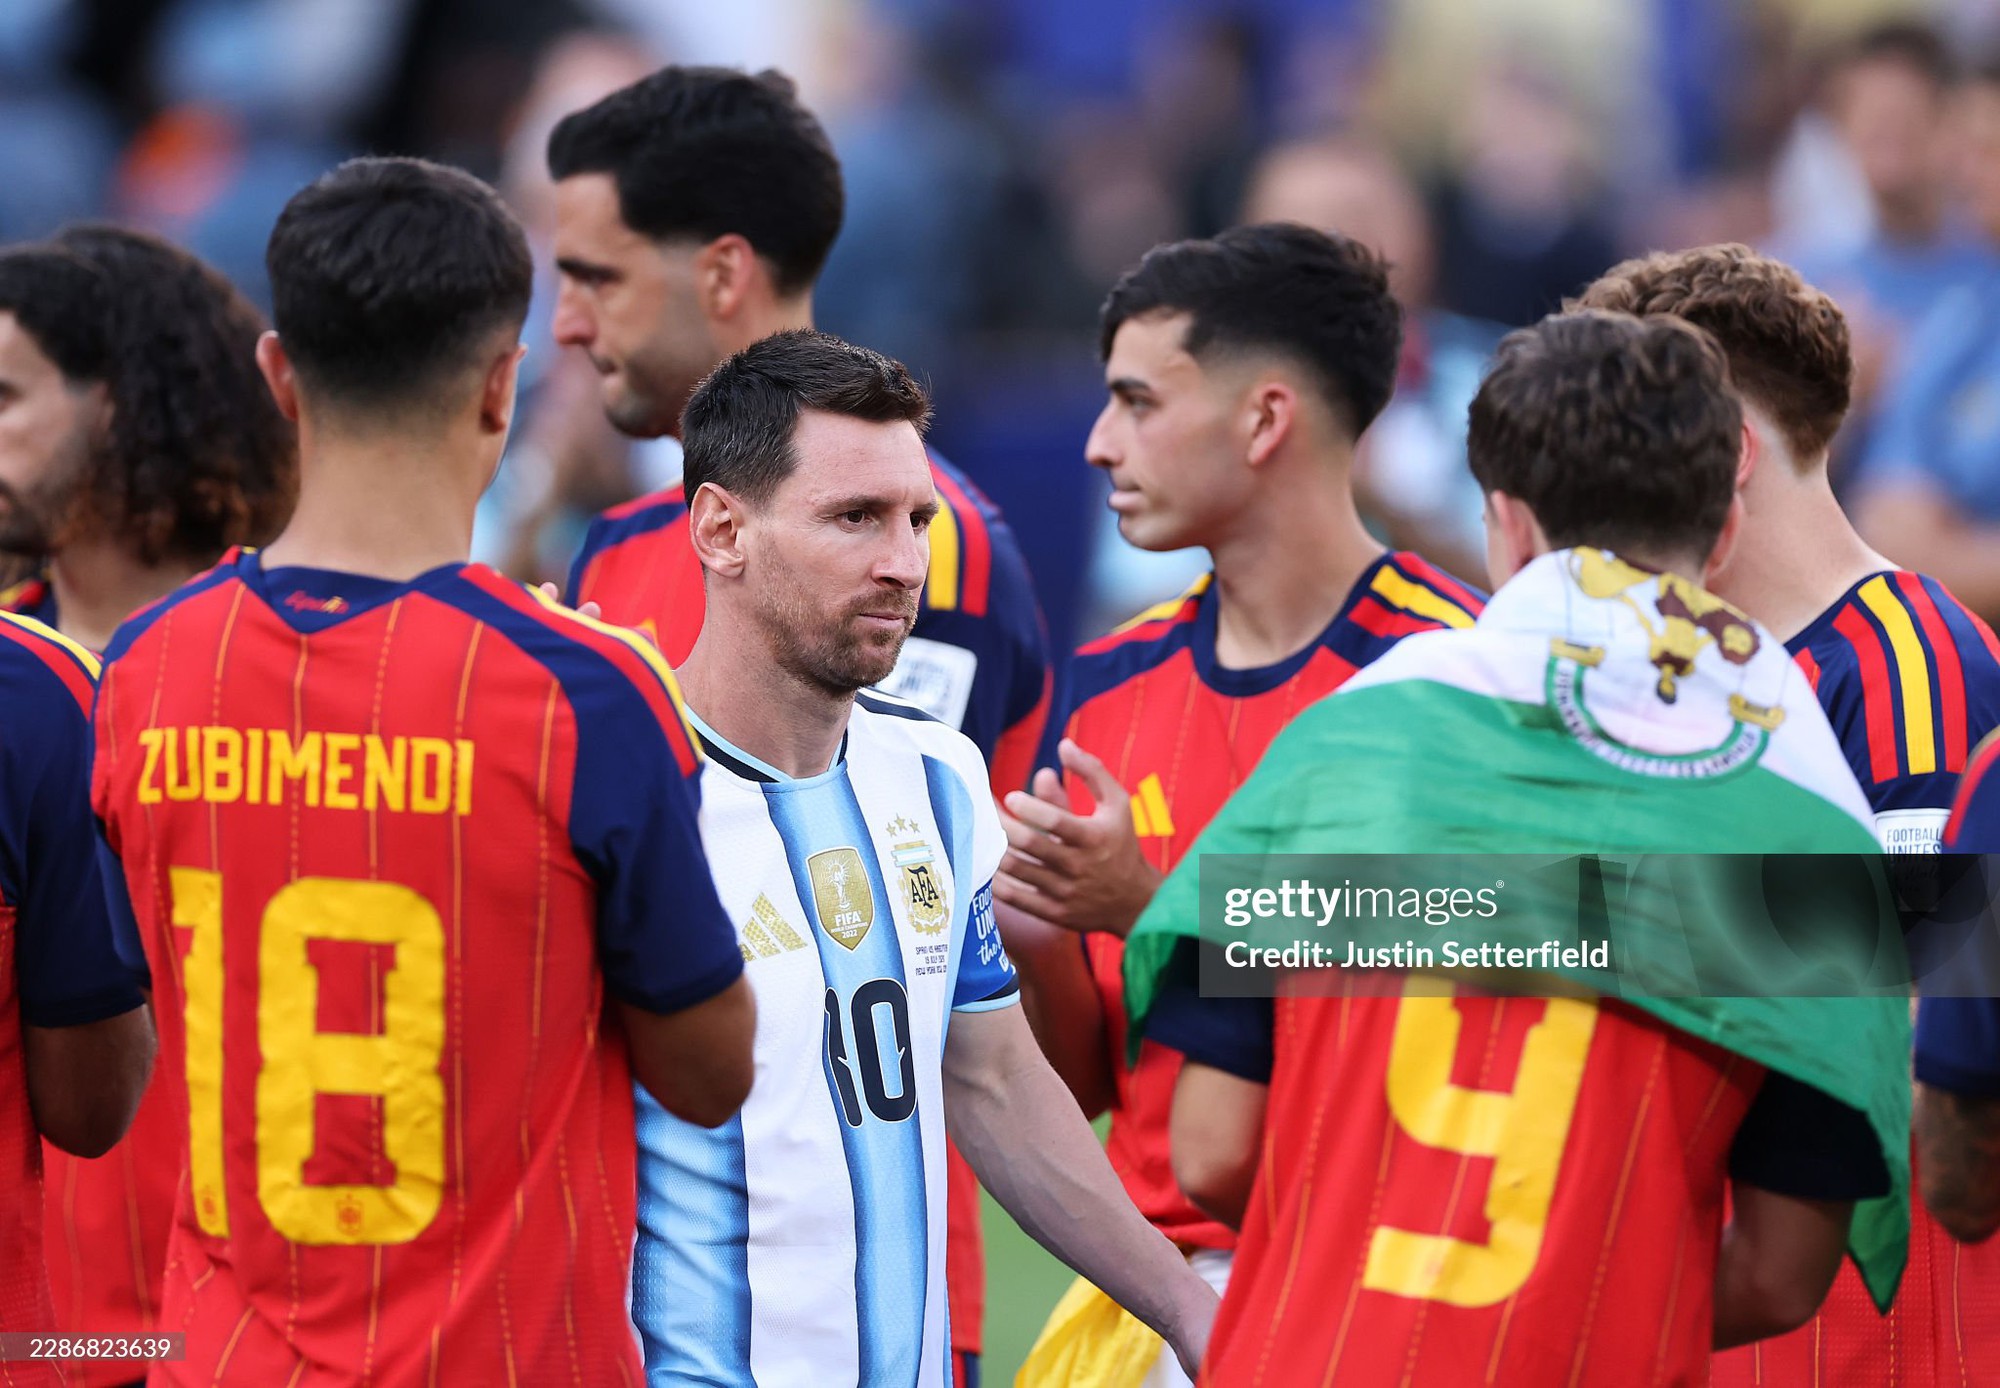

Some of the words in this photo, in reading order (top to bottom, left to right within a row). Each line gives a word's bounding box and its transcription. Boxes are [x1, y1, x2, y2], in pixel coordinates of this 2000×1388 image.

[138, 726, 475, 815] ZUBIMENDI
[1886, 827, 1941, 843] FOOTBALL
[834, 910, 862, 927] FIFA
[972, 886, 993, 916] FOO
[841, 929, 858, 939] 2022
[169, 865, 446, 1246] 18
[825, 978, 917, 1128] 10
[1363, 972, 1599, 1308] 9
